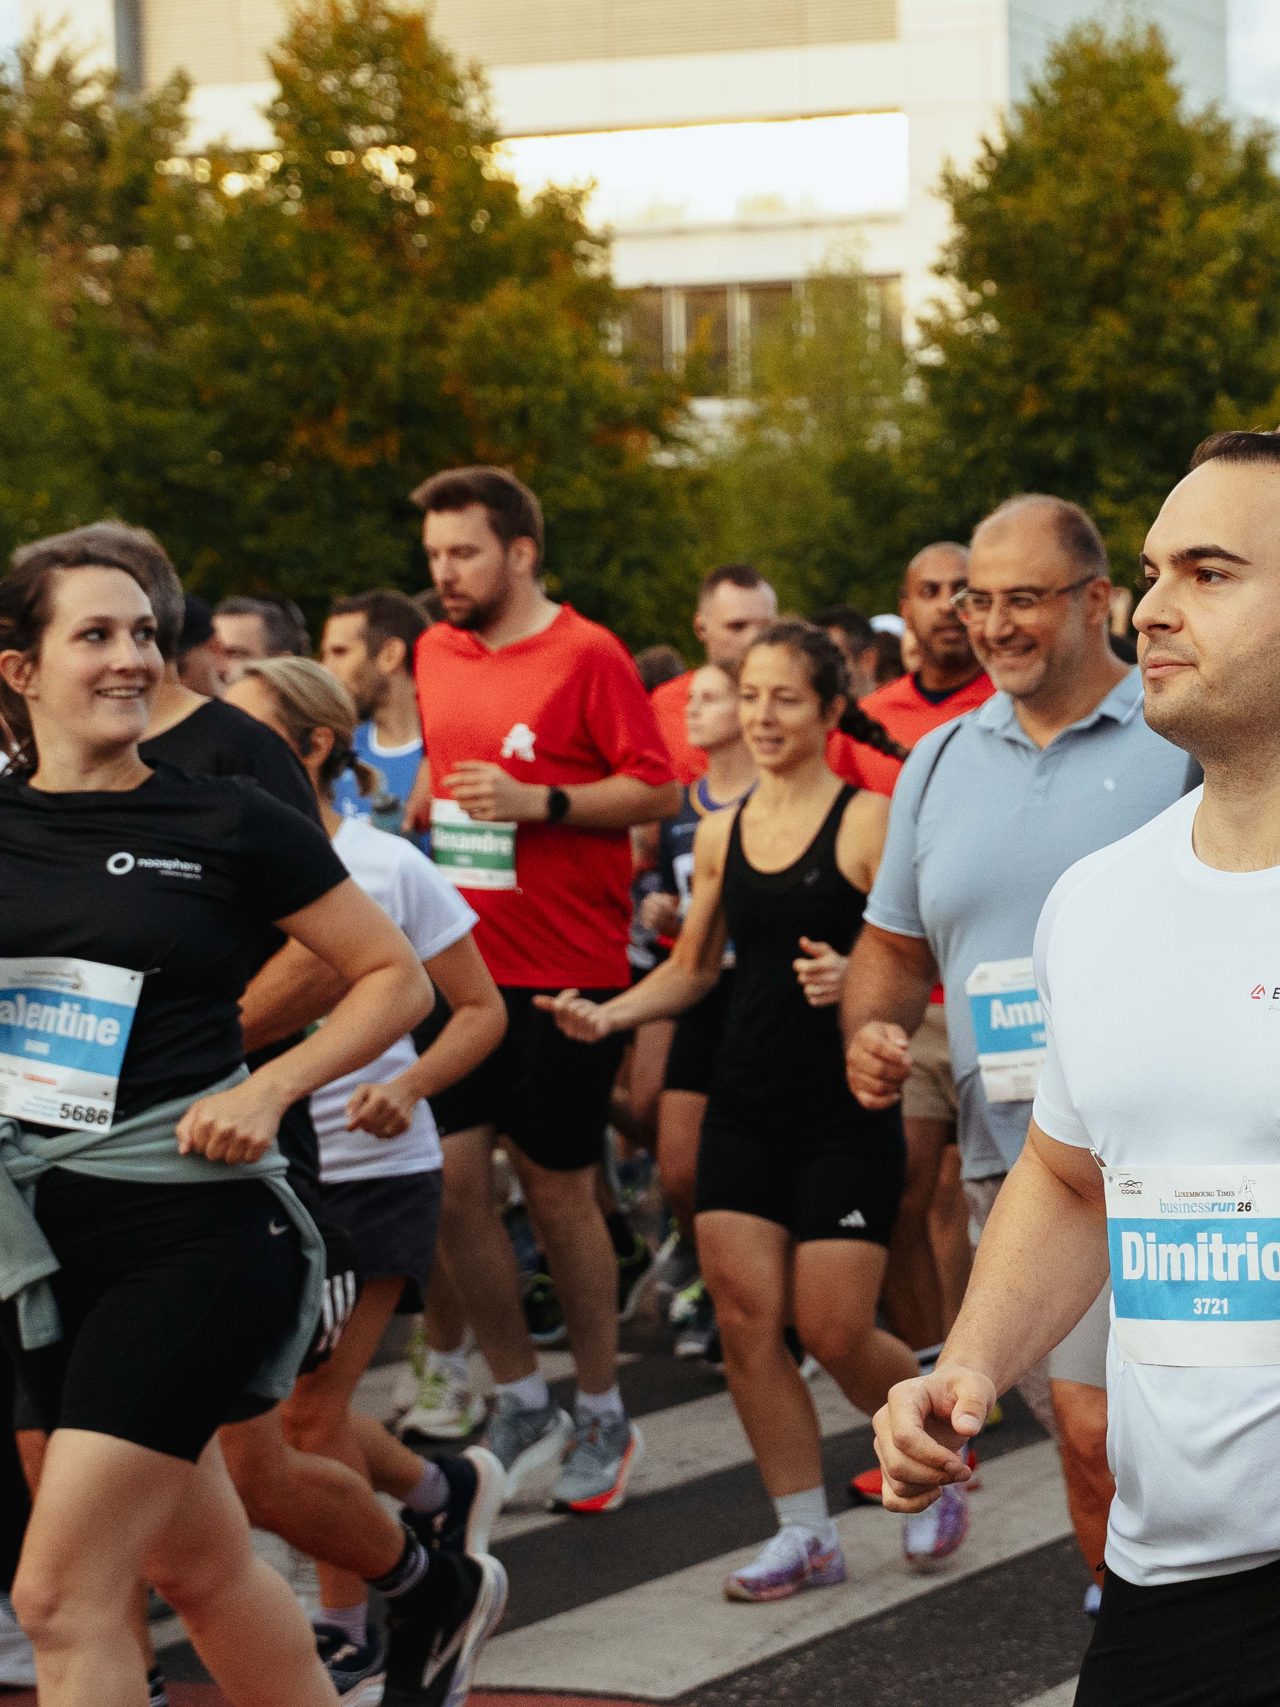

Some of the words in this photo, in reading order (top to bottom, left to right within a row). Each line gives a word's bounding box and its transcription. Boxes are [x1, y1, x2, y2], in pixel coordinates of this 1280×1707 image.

[60, 1103, 109, 1125] 5686
[1237, 1202, 1252, 1212] 26
[1193, 1298, 1229, 1315] 3721
